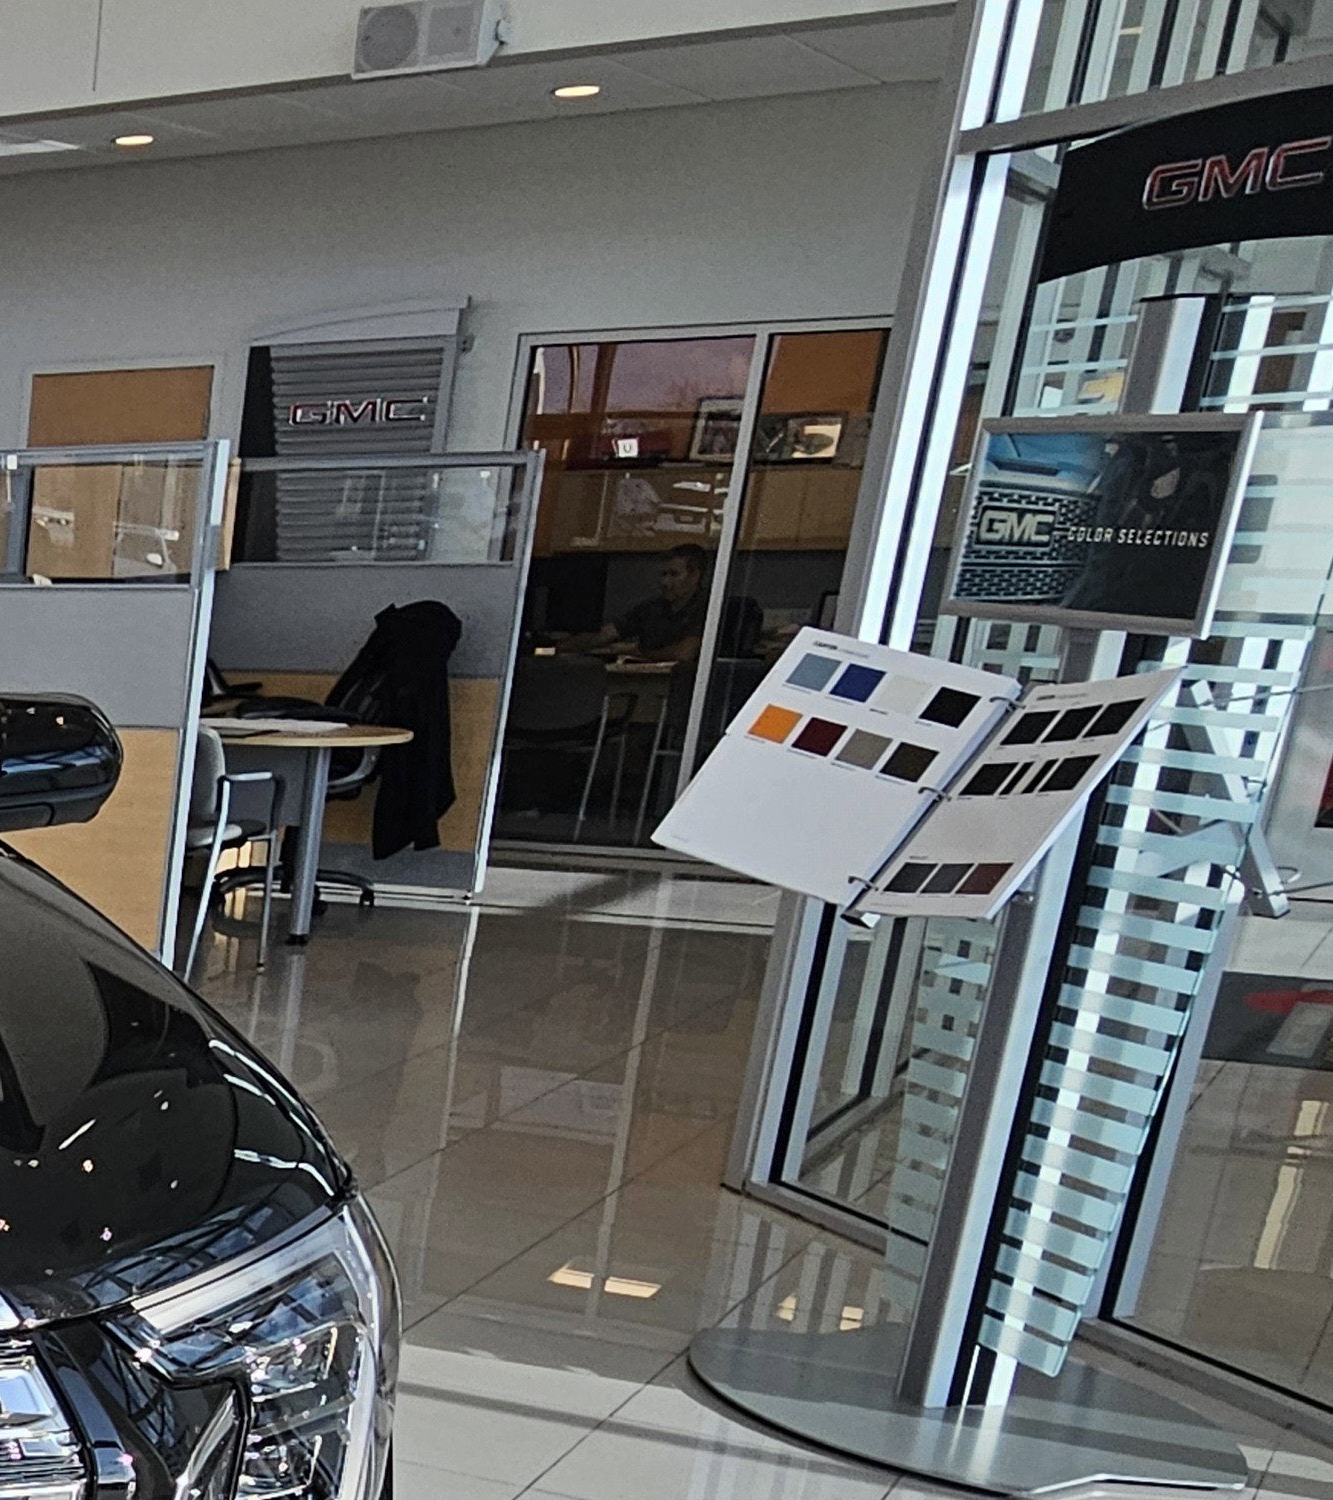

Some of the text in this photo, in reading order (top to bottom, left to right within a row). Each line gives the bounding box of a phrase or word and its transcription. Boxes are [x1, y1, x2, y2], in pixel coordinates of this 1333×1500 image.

[1142, 135, 1332, 210] GMC
[289, 396, 428, 426] GMC
[979, 509, 1055, 543] GMC
[1067, 526, 1209, 548] COLOR SELECTIONS
